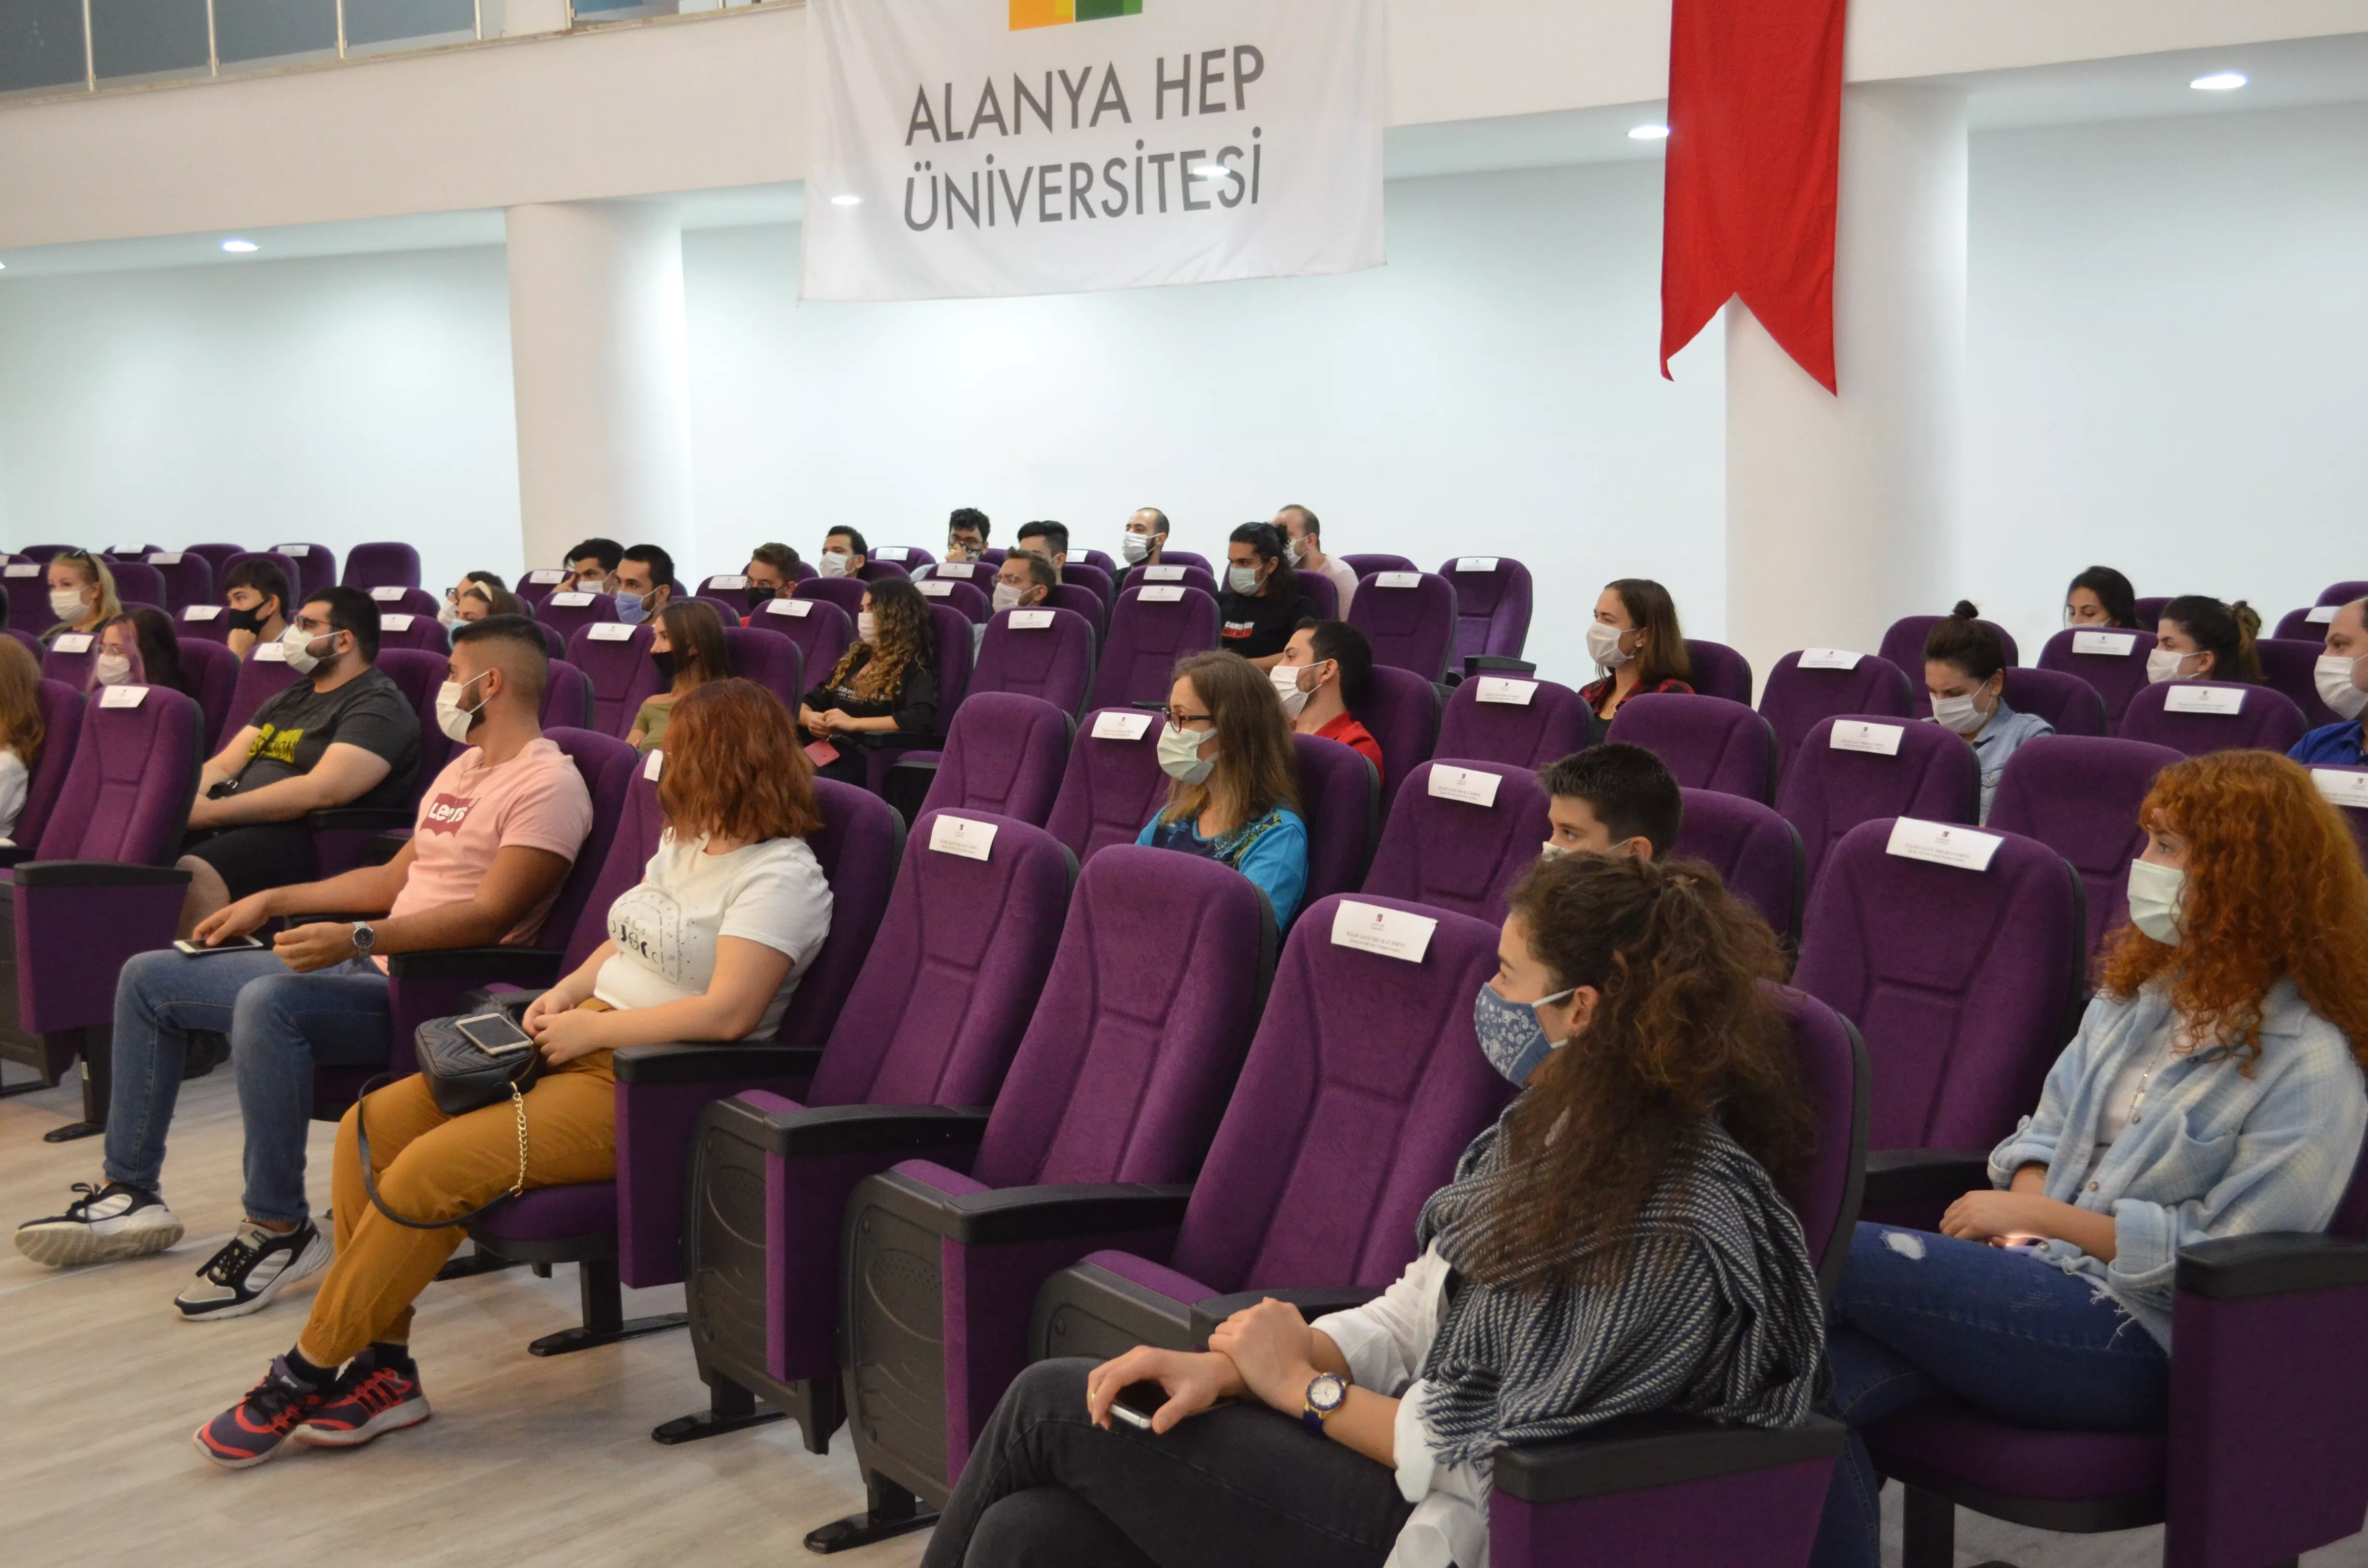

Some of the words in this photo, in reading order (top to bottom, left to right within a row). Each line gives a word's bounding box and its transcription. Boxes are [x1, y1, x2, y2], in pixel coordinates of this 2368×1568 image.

[904, 62, 1132, 146] ALANYA
[1156, 44, 1264, 120] HEP
[904, 126, 1262, 232] ÜNİVERSİTESİ
